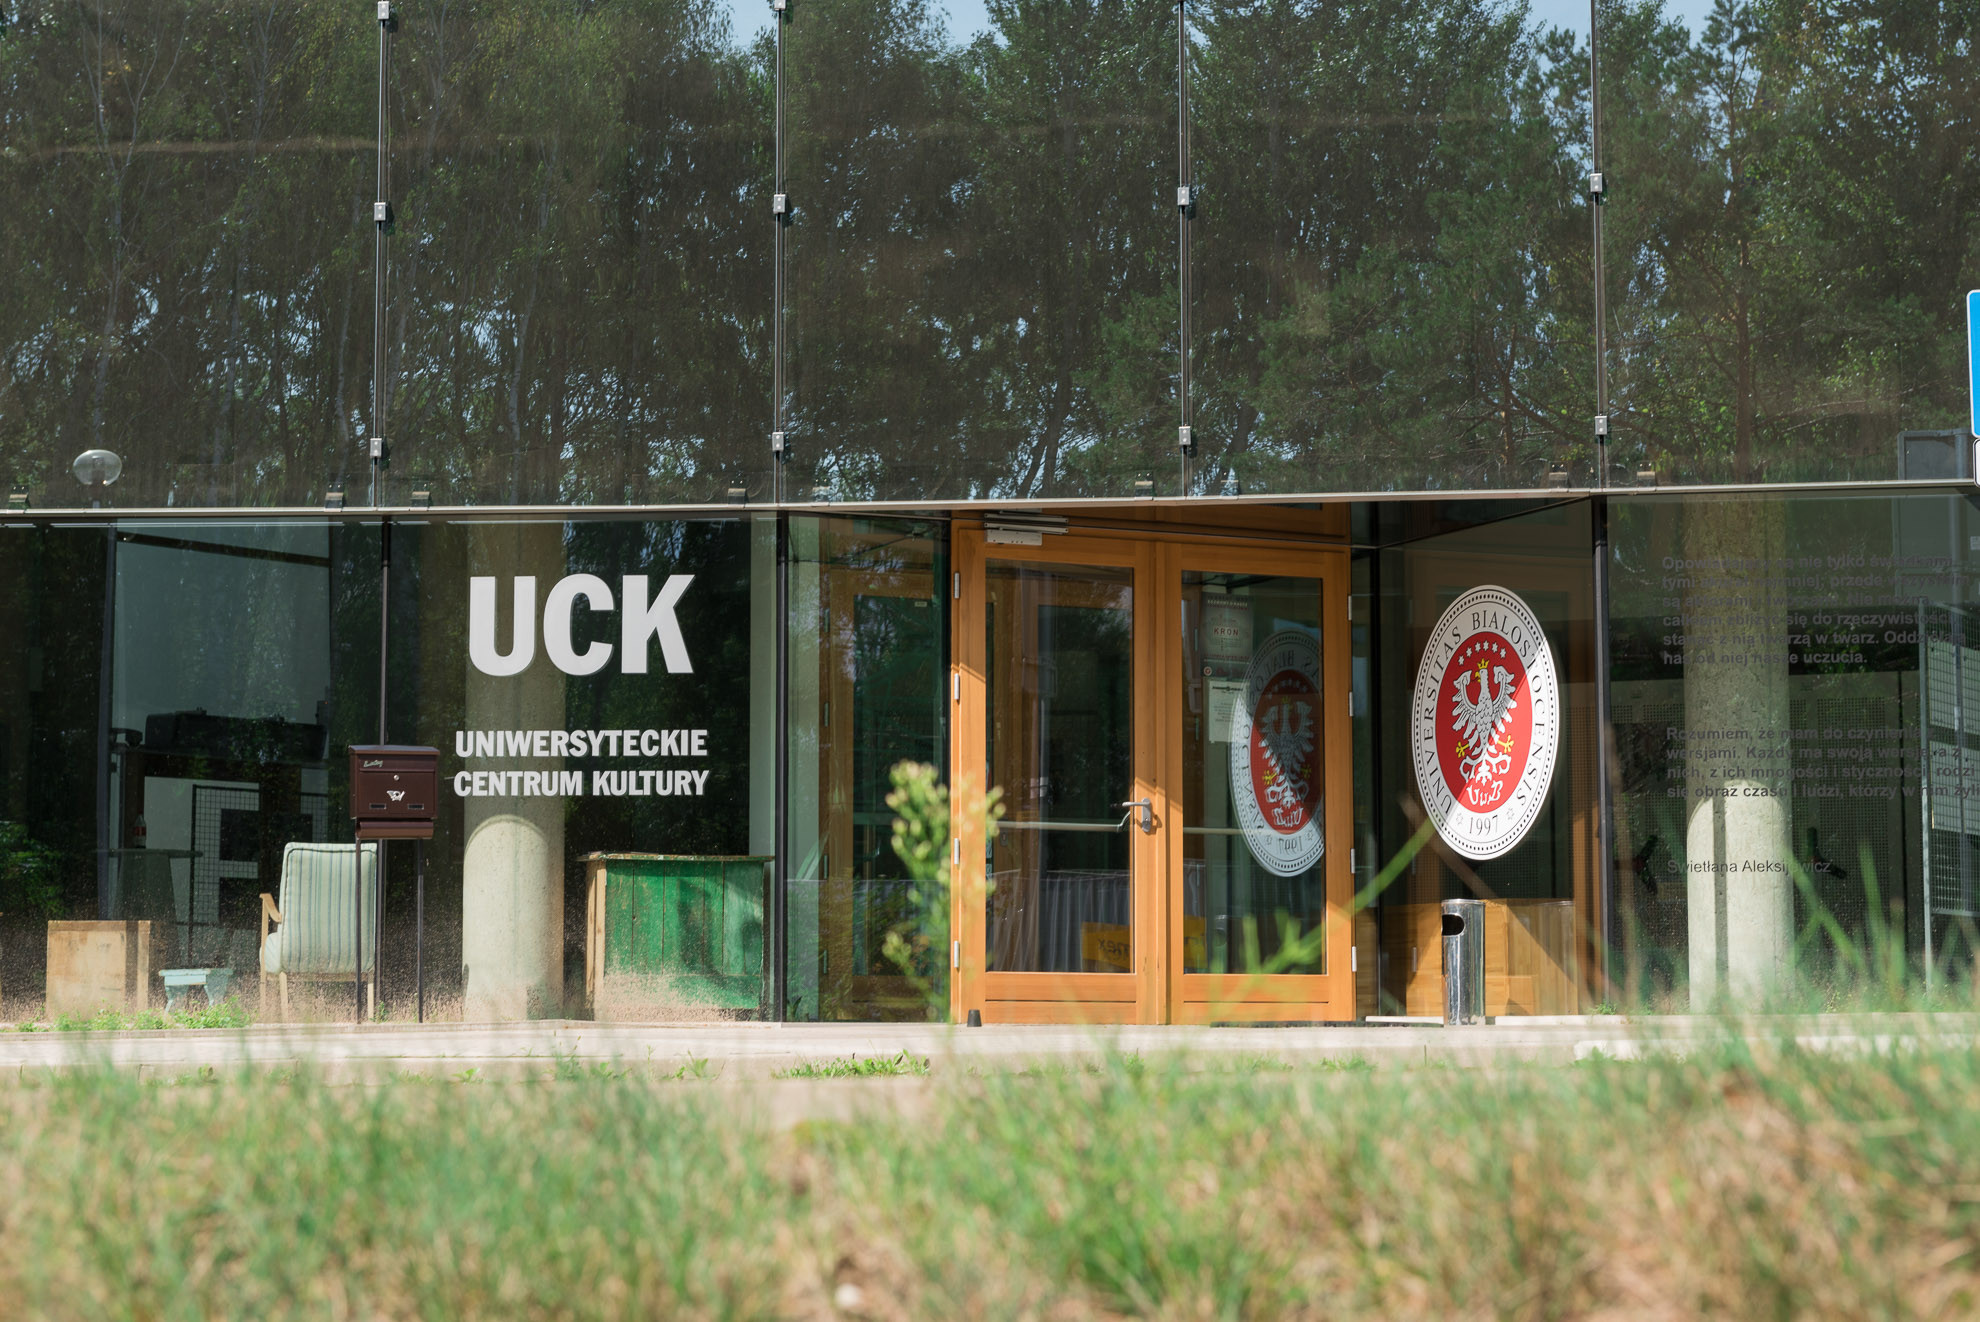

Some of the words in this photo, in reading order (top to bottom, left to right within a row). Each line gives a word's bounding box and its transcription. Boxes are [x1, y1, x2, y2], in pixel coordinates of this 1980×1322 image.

[1799, 555, 1822, 569] nie
[1826, 553, 1865, 571] tylko
[1662, 575, 1696, 592] tymi
[1830, 574, 1883, 589] przede
[1663, 597, 1681, 610] są
[1686, 594, 1753, 607] aktorami
[1847, 592, 1874, 606] Nie
[469, 573, 695, 676] UCK
[1663, 613, 1722, 627] całkiem
[1785, 612, 1808, 629] się
[1812, 609, 1833, 625] do
[1663, 632, 1715, 647] stanąć
[1719, 635, 1728, 645] z
[1732, 632, 1756, 649] nią
[1760, 632, 1811, 648] twarzą
[1815, 634, 1829, 644] w
[1833, 631, 1880, 645] twarz.
[1696, 651, 1716, 664] od
[1721, 651, 1748, 667] niej
[1752, 653, 1798, 664] nasze
[1803, 651, 1868, 665] uczucia.
[1470, 609, 1547, 808] BIALOSTOCENSIS
[1422, 624, 1462, 816] UNIVERSITAS
[1666, 727, 1753, 741] Rozumiem,
[1758, 727, 1775, 739] że
[1781, 728, 1818, 739] mam
[1823, 726, 1843, 740] do
[455, 729, 708, 758] UNIWERSYTECKIE
[1667, 746, 1741, 761] wersjami.
[1799, 748, 1822, 758] ma
[1827, 746, 1873, 763] swoją
[1938, 748, 1947, 758] a
[1667, 766, 1705, 780] nich,
[1709, 768, 1718, 778] z
[1722, 765, 1746, 778] ich
[1751, 764, 1828, 781] mnogości
[1936, 763, 1975, 777] rodzi
[453, 770, 584, 798] CENTRUM
[592, 769, 710, 797] KULTURY
[1667, 785, 1689, 801] się
[1695, 784, 1738, 798] obraz
[1743, 786, 1787, 798] czasu
[1802, 783, 1844, 800] ludzi,
[1848, 783, 1896, 801] którzy
[1903, 786, 1915, 797] w
[1467, 814, 1499, 836] 1997
[1667, 858, 1738, 873] Swietłana
[1741, 858, 1832, 876] Aleksijewicz
